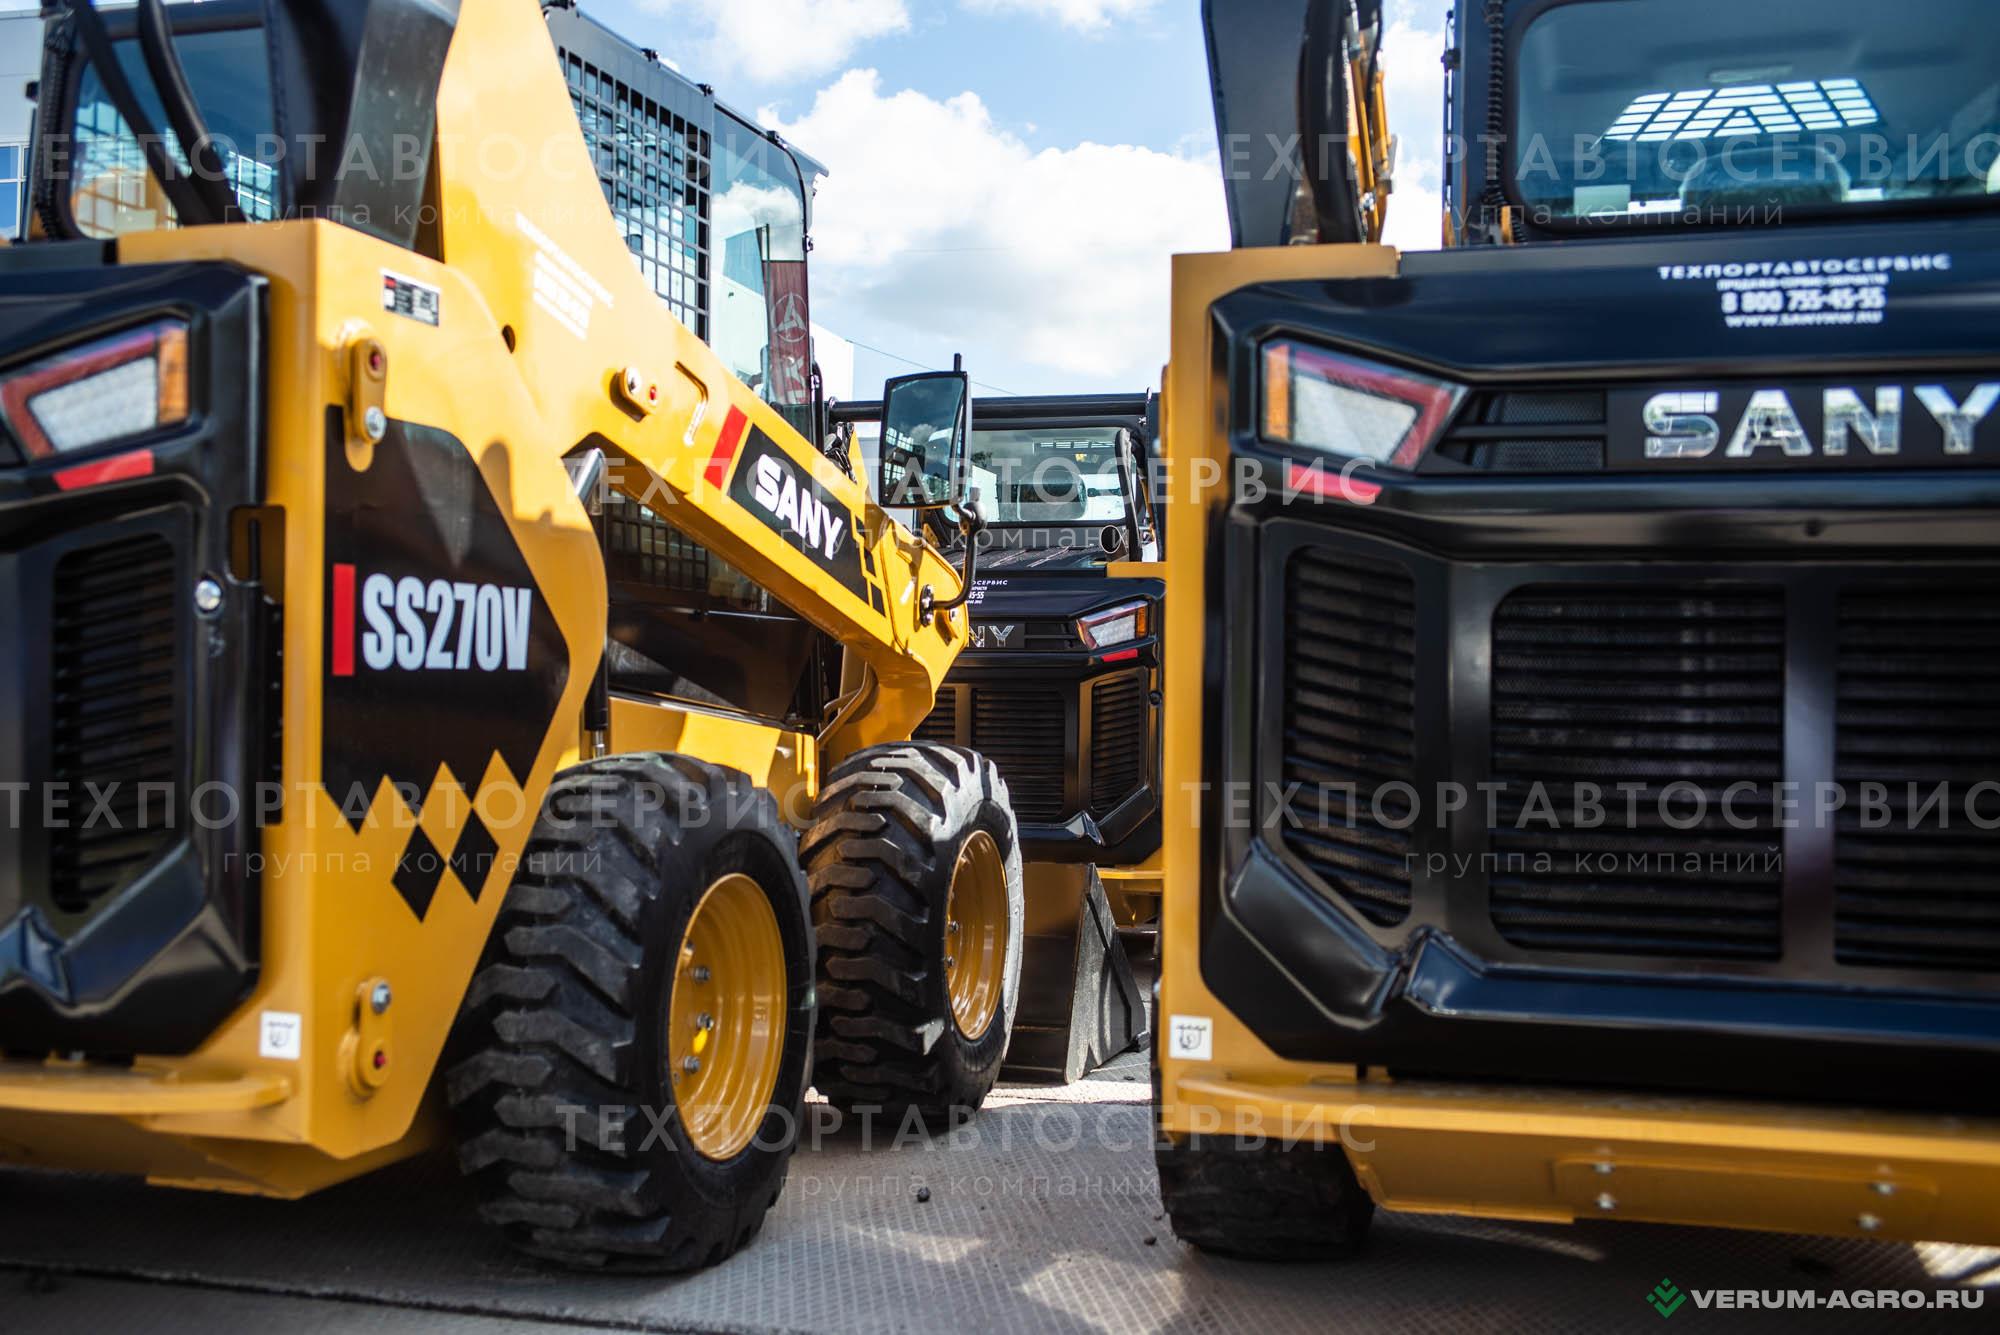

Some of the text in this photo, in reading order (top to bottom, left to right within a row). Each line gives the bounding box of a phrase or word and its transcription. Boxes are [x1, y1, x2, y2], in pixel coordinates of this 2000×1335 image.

[1657, 254, 1951, 280] ТЕХПОРТАВТОСЕРВИС
[1643, 383, 2000, 458] SANY
[755, 454, 843, 560] SANY
[363, 573, 532, 672] SS270V
